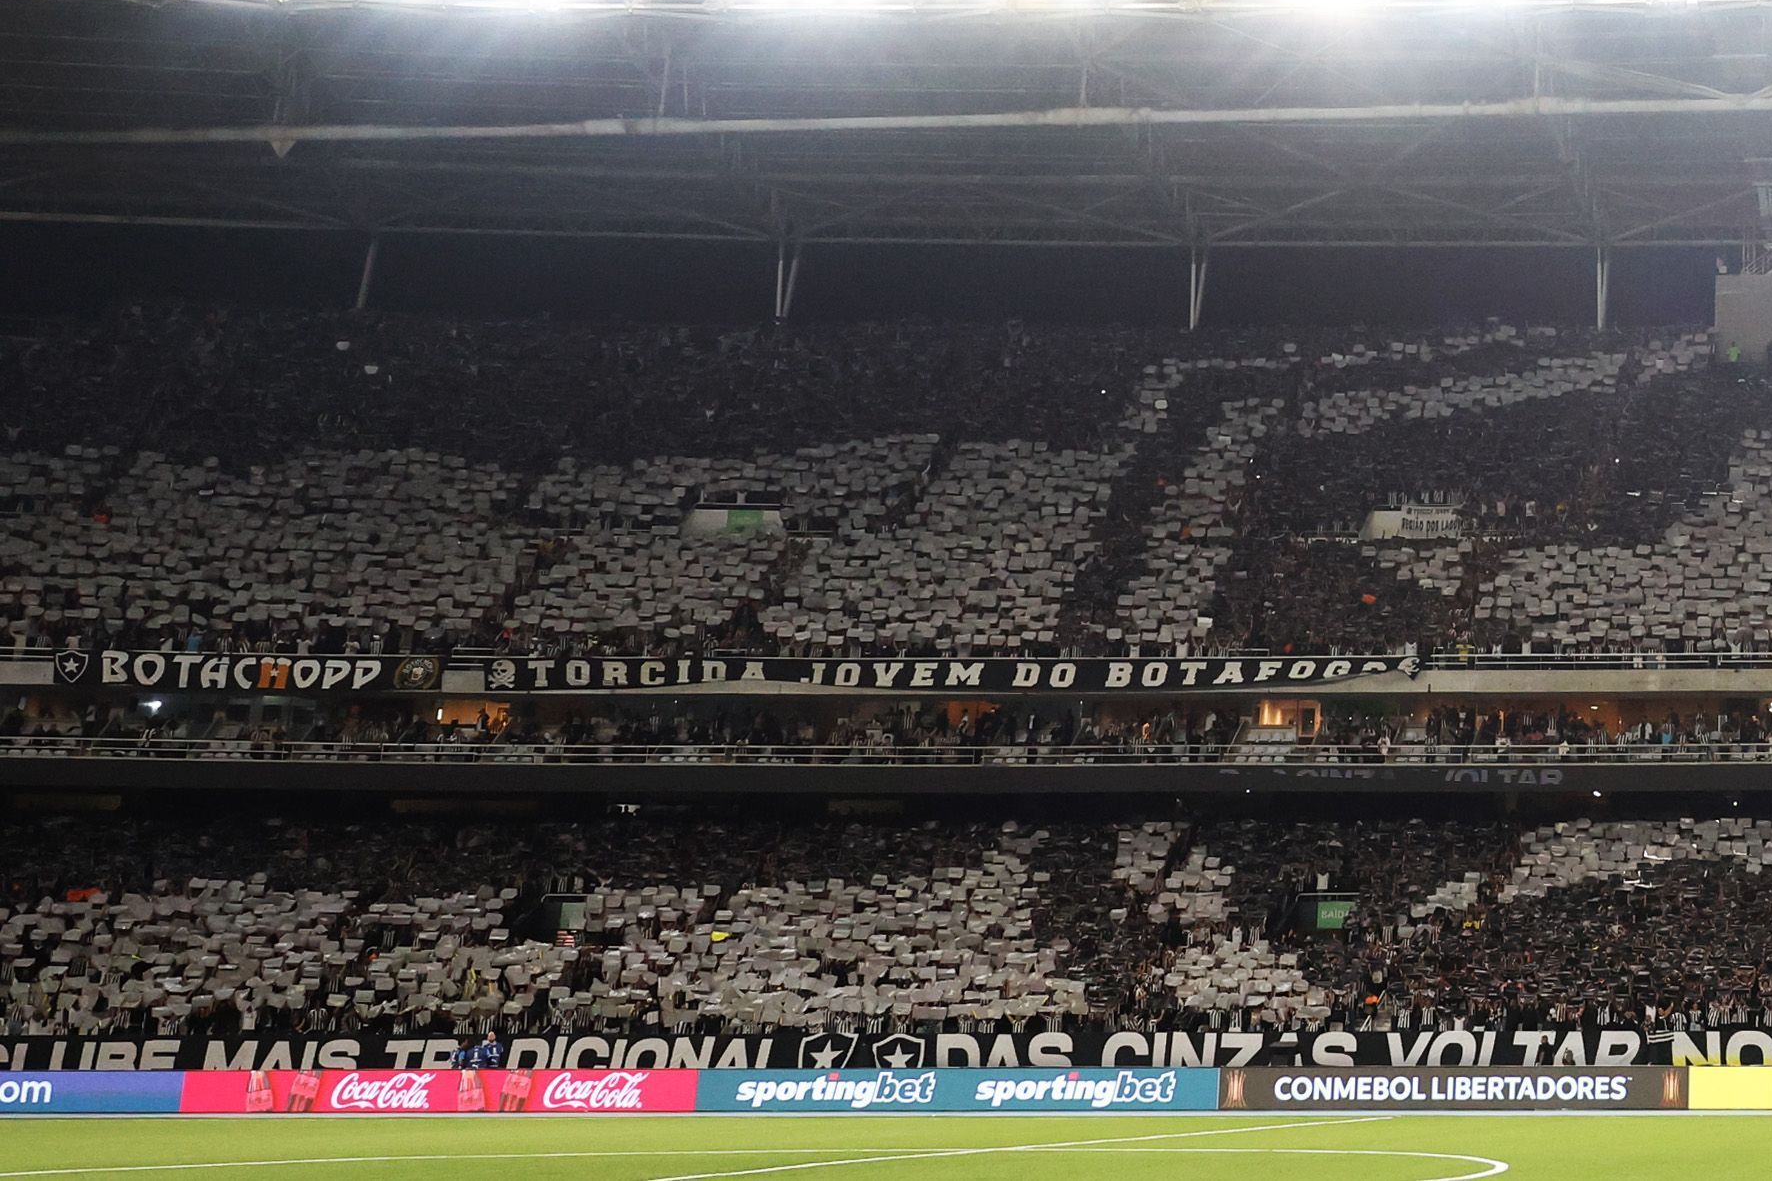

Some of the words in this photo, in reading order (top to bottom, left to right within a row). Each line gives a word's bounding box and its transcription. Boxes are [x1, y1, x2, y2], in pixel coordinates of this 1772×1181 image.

[528, 659, 765, 687] TORCIDA
[801, 662, 985, 687] JOVEM
[1012, 662, 1077, 688] DO
[0, 1040, 181, 1071] LUBE
[202, 1039, 360, 1070] MAIS
[385, 1035, 774, 1070] TRDICIONAL
[936, 1032, 1074, 1068] DAS
[1387, 1030, 1641, 1067] VOLTAR
[331, 1071, 435, 1109] Coca-Cola
[544, 1071, 649, 1109] Coca-Cola
[736, 1071, 936, 1108] sportingbet
[975, 1070, 1177, 1107] sportingbet
[1273, 1075, 1426, 1102] CONMEBOL
[1430, 1075, 1628, 1102] LIBERTADORES
